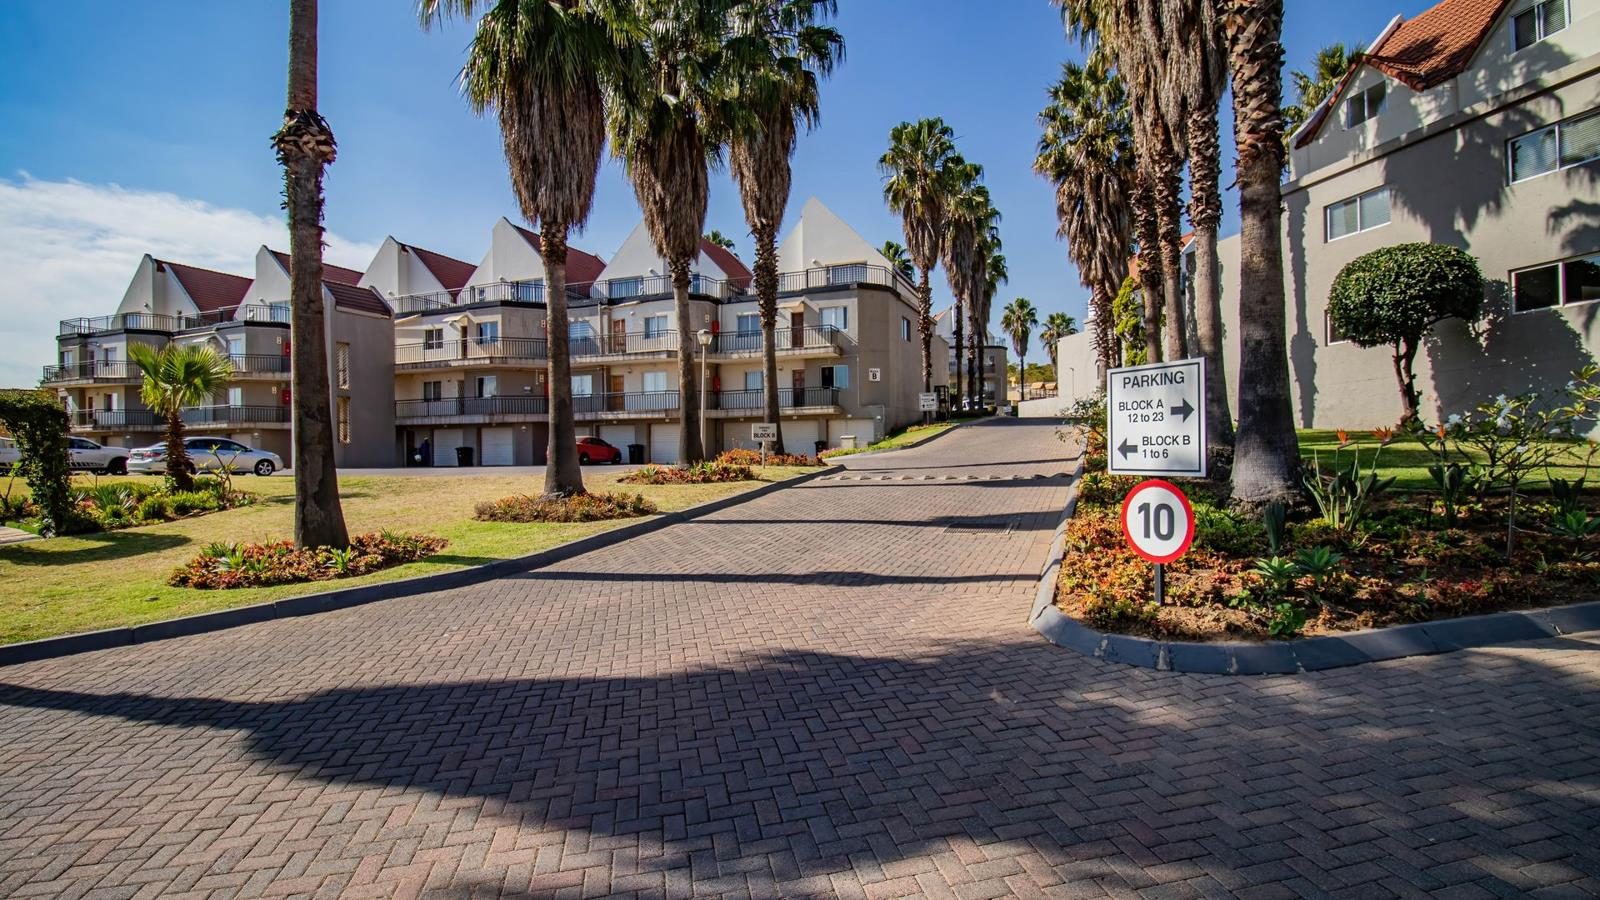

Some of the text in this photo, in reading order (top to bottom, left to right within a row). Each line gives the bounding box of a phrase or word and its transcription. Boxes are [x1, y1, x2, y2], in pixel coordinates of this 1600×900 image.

[1123, 371, 1185, 389] PARKING
[1118, 399, 1164, 412] BLOCK A
[1128, 412, 1164, 423] 12 to 23
[1142, 435, 1190, 446] BLOCK B
[1143, 449, 1168, 458] 1 to 6
[1138, 502, 1174, 541] 10
